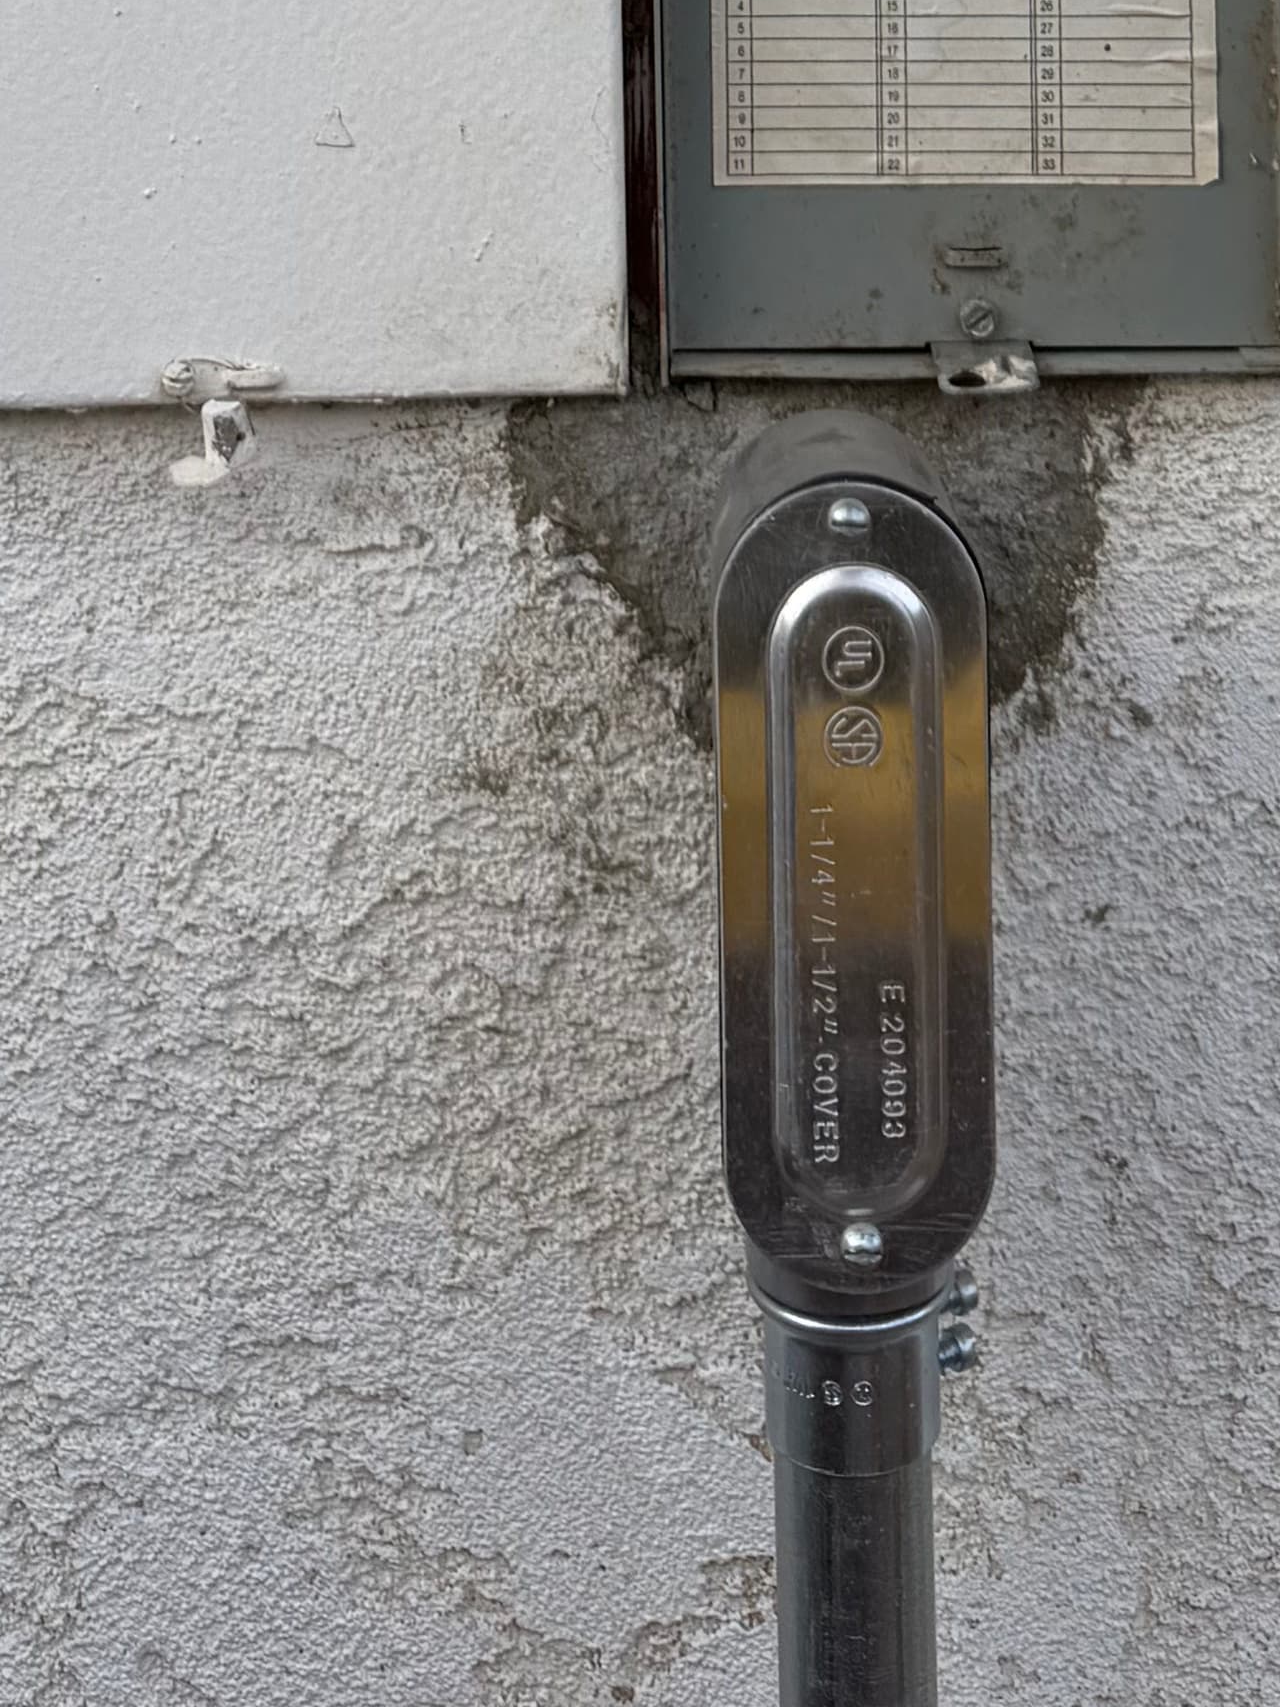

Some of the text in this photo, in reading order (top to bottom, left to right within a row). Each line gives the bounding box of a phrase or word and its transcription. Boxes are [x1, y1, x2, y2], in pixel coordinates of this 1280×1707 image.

[738, 1, 744, 11] 4
[887, 1, 898, 11] 15
[1040, 1, 1053, 11] 26
[738, 23, 744, 34] 5
[887, 23, 898, 34] 16
[1040, 23, 1052, 33] 27
[738, 46, 745, 56] 6
[887, 46, 898, 56] 17
[1041, 46, 1053, 56] 28
[738, 69, 745, 79] 7
[887, 68, 898, 79] 18
[1041, 69, 1054, 79] 29
[738, 92, 745, 102] 8
[887, 91, 899, 102] 19
[1042, 91, 1054, 101] 30
[738, 113, 746, 124] 9
[888, 113, 899, 124] 20
[1042, 113, 1053, 124] 31
[733, 136, 746, 147] 10
[888, 136, 898, 147] 21
[1042, 136, 1054, 147] 32
[733, 159, 745, 170] 11
[888, 160, 900, 170] 22
[1043, 160, 1055, 170] 33
[835, 640, 872, 678] UL
[880, 983, 907, 1139] E 204093
[812, 1053, 840, 1163] COVER
